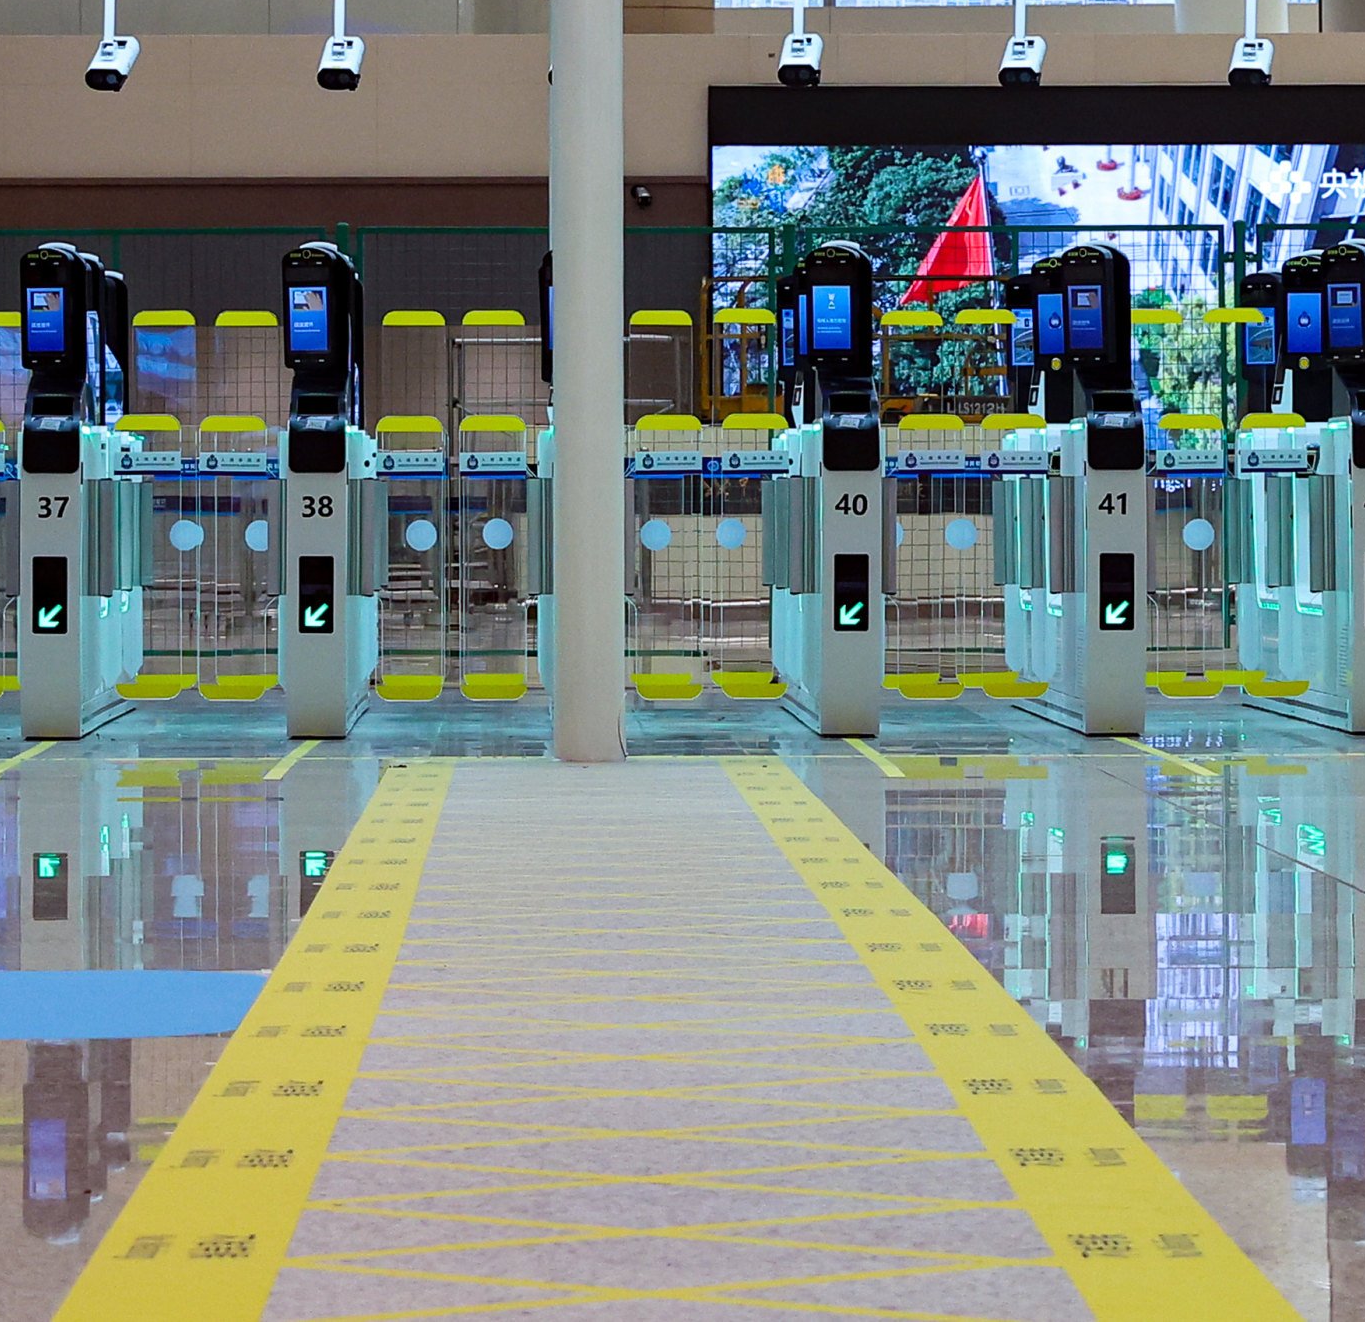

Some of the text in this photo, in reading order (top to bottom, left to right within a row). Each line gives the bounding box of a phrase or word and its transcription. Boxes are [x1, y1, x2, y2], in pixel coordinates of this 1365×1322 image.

[37, 496, 70, 519] 37
[301, 495, 334, 518] 38
[834, 493, 868, 516] 40
[1098, 492, 1127, 515] 41
